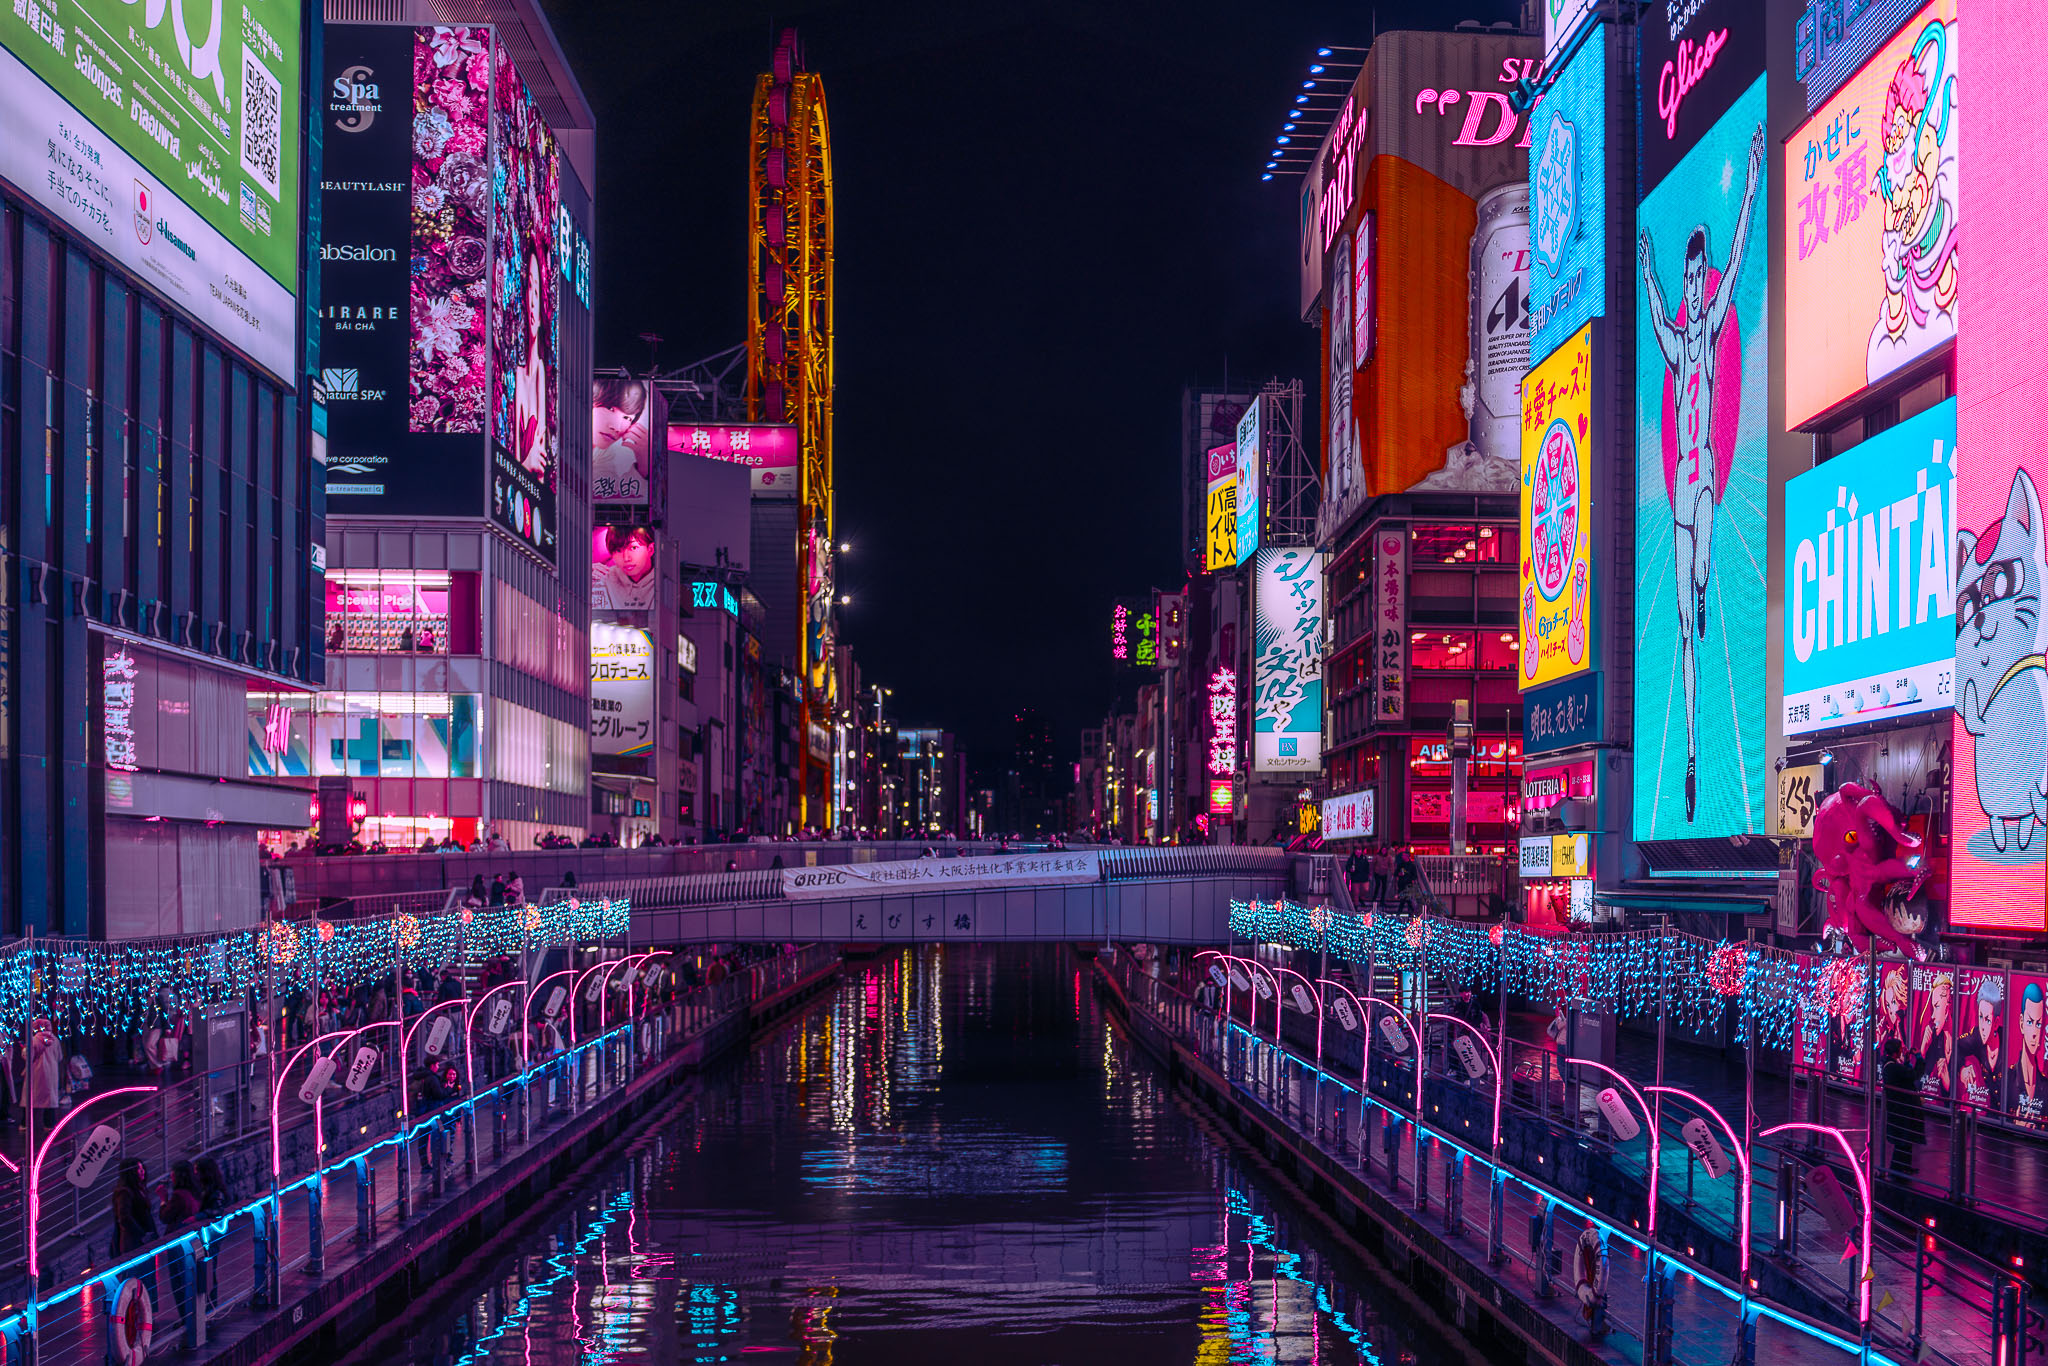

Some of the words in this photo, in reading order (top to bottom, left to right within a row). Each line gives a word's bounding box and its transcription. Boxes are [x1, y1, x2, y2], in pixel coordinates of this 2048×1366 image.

[333, 77, 379, 104] Spa
[1659, 27, 1728, 140] Glico
[330, 103, 382, 112] treatment
[1804, 107, 1861, 182] かぜに
[48, 138, 113, 208] 気になるそこに、
[48, 169, 113, 236] 手当てのチカラを。
[1798, 140, 1872, 261] 改源
[156, 217, 197, 262] Hisamitsu
[1687, 363, 1702, 485] グリコ
[691, 430, 750, 450] 免税
[340, 455, 388, 463] corporation
[733, 454, 763, 465] Free
[1210, 489, 1225, 566] バイト
[336, 594, 380, 606] Scenic
[384, 594, 415, 606] Plac
[591, 662, 647, 680] プロデュース
[1207, 667, 1236, 774] 大阪王将
[1788, 703, 1810, 724] 天気予報
[1281, 742, 1295, 751] BX
[1525, 778, 1559, 798] LOTTERIA
[938, 859, 1088, 878] 大阪活性化事業実行委員会
[855, 913, 971, 930] えびす橋
